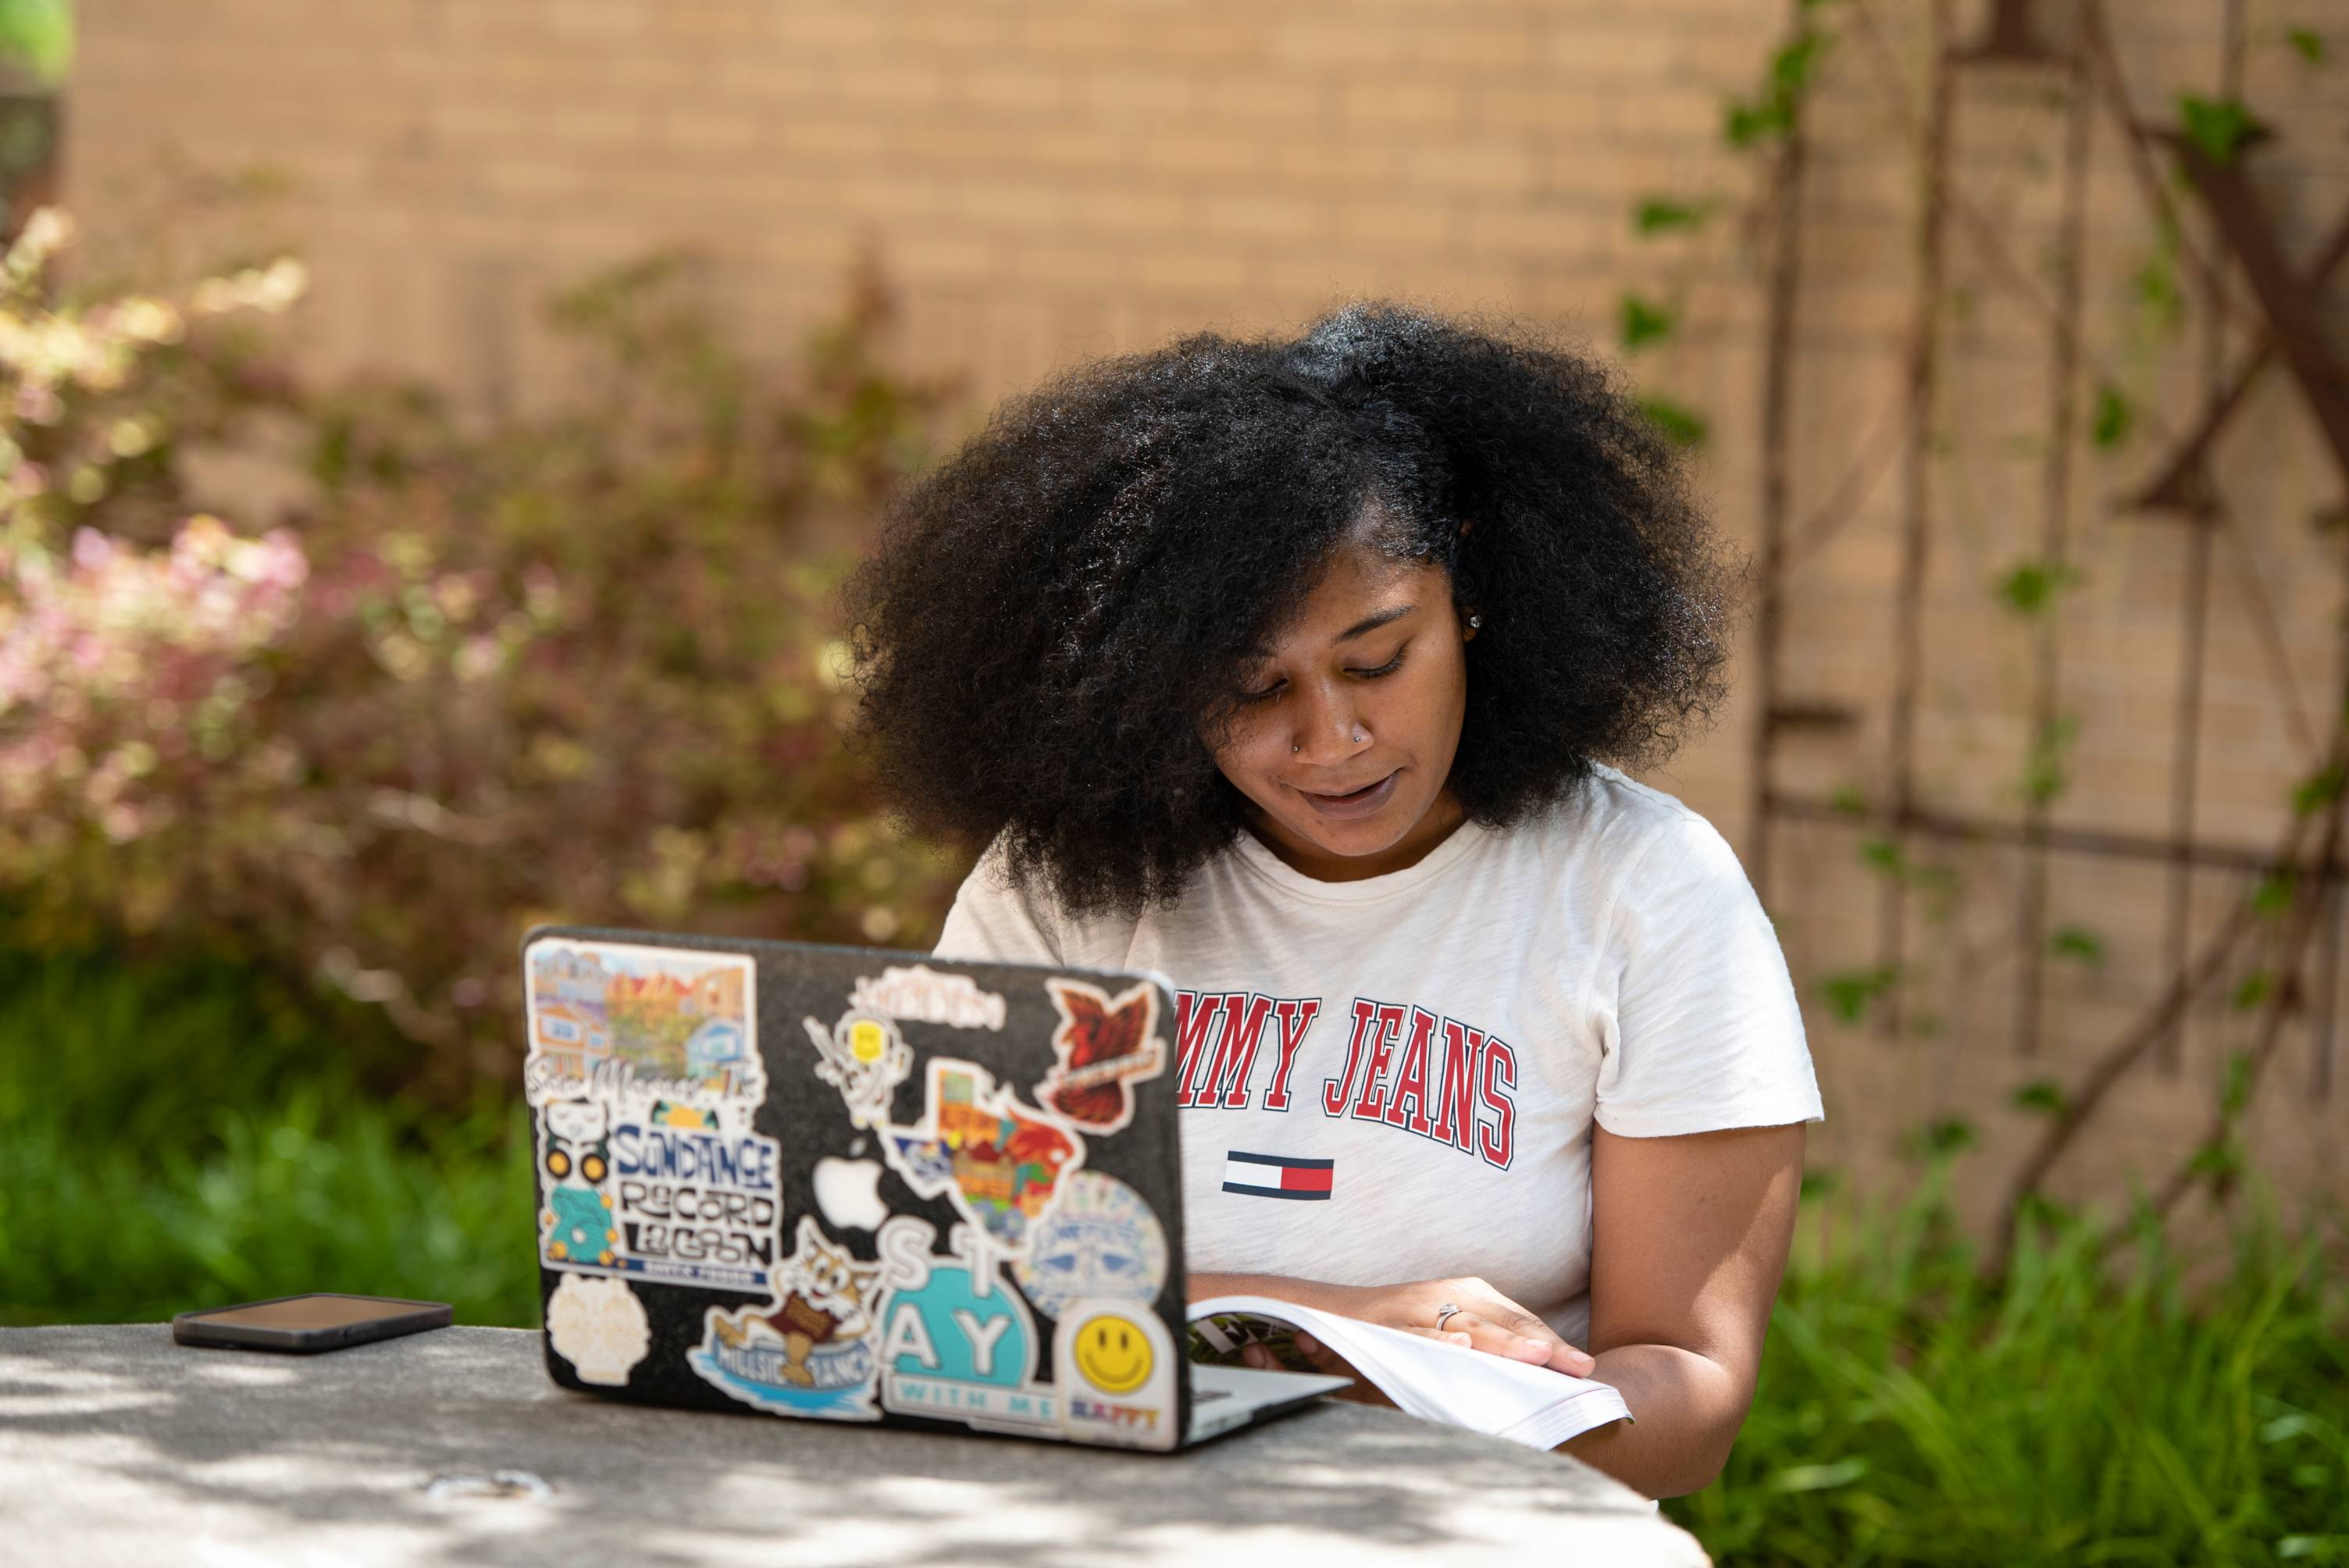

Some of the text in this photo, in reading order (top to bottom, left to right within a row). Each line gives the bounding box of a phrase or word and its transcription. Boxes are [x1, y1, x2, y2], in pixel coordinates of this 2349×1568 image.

[1321, 997, 1517, 1171] JEANS
[899, 1383, 986, 1406] WITH
[1071, 1398, 1160, 1431] HAPPY
